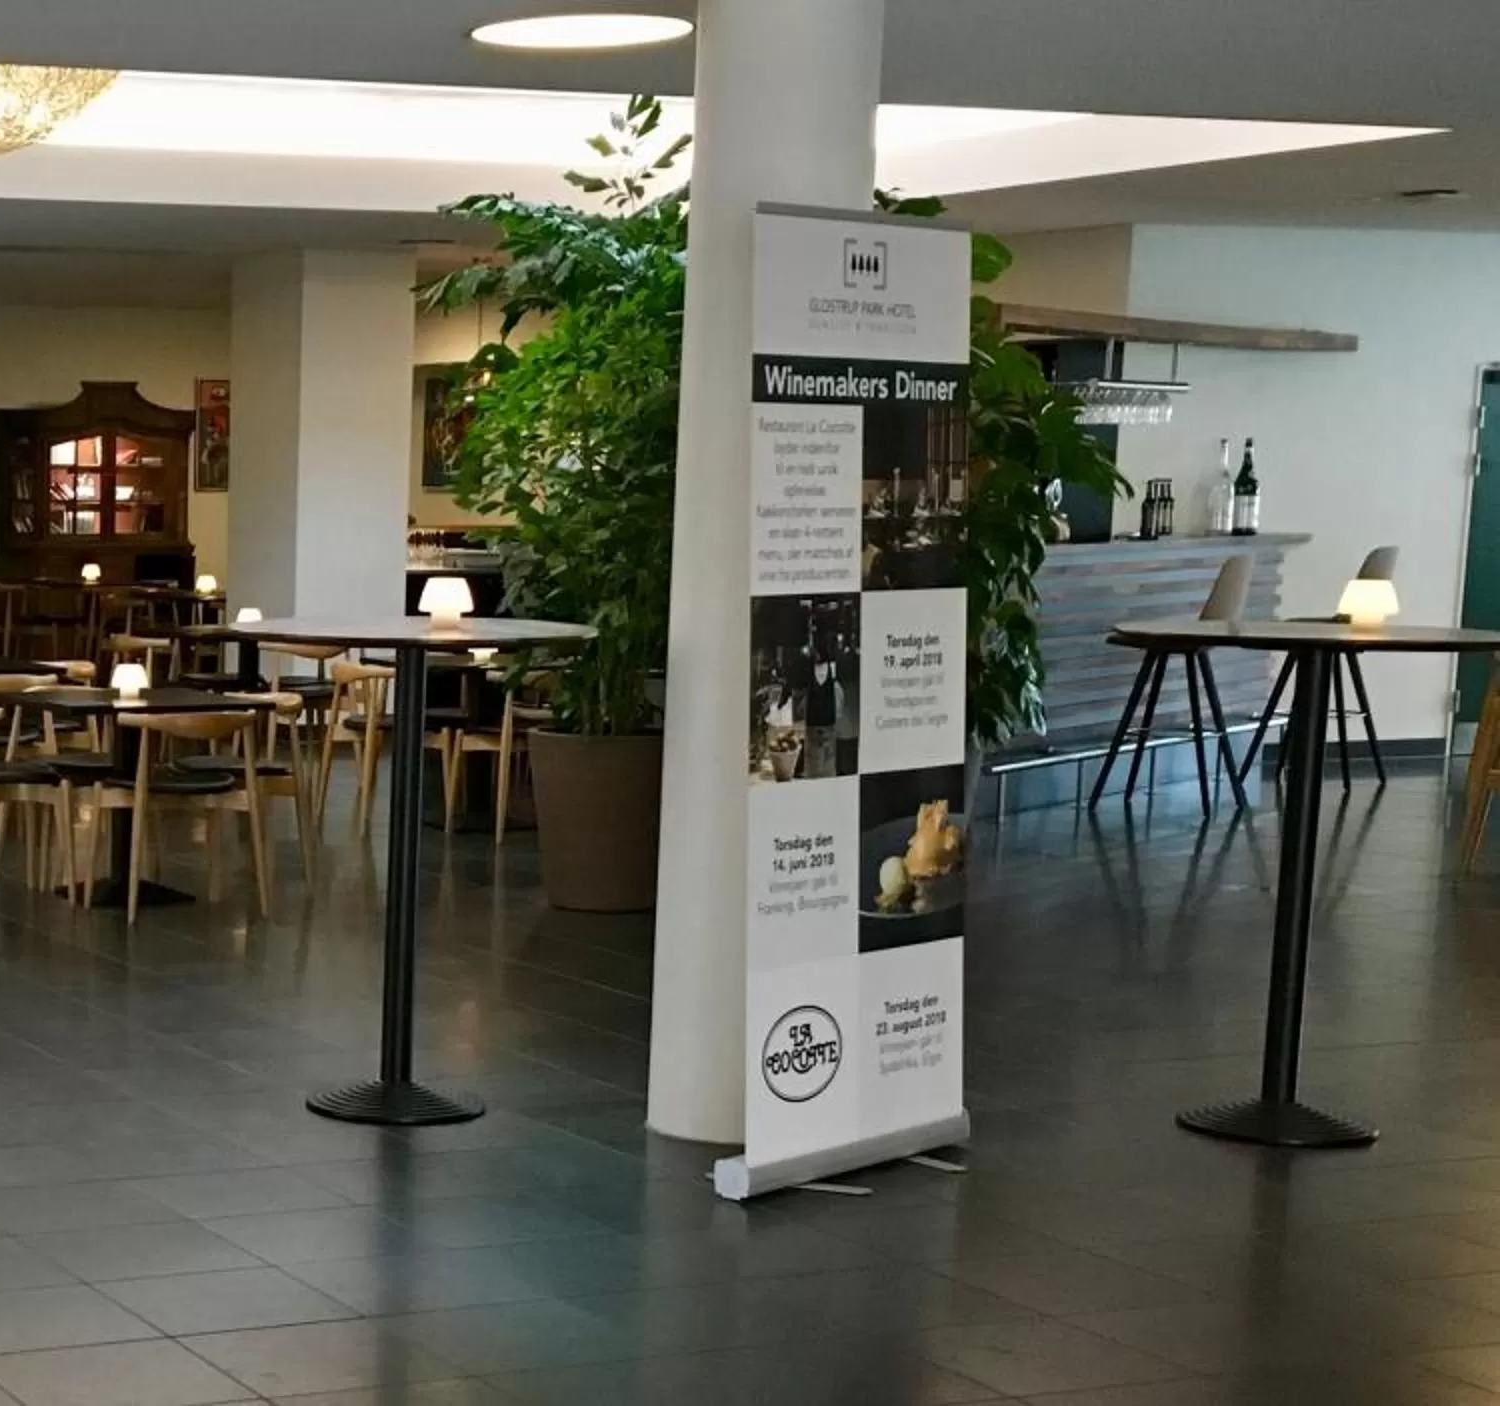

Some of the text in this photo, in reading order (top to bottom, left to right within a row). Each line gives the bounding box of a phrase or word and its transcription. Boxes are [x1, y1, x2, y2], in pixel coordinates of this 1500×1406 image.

[764, 364, 958, 401] Winemakers Dinner
[886, 634, 939, 650] Torsdag den
[900, 653, 921, 671] april
[922, 651, 942, 667] 2018
[773, 834, 833, 852] Torsdag den
[789, 856, 808, 874] juni
[810, 851, 835, 869] 2018
[884, 994, 939, 1014] Torsdag den
[892, 1016, 922, 1035] august
[924, 1009, 947, 1027] 2018
[789, 1023, 813, 1047] LA
